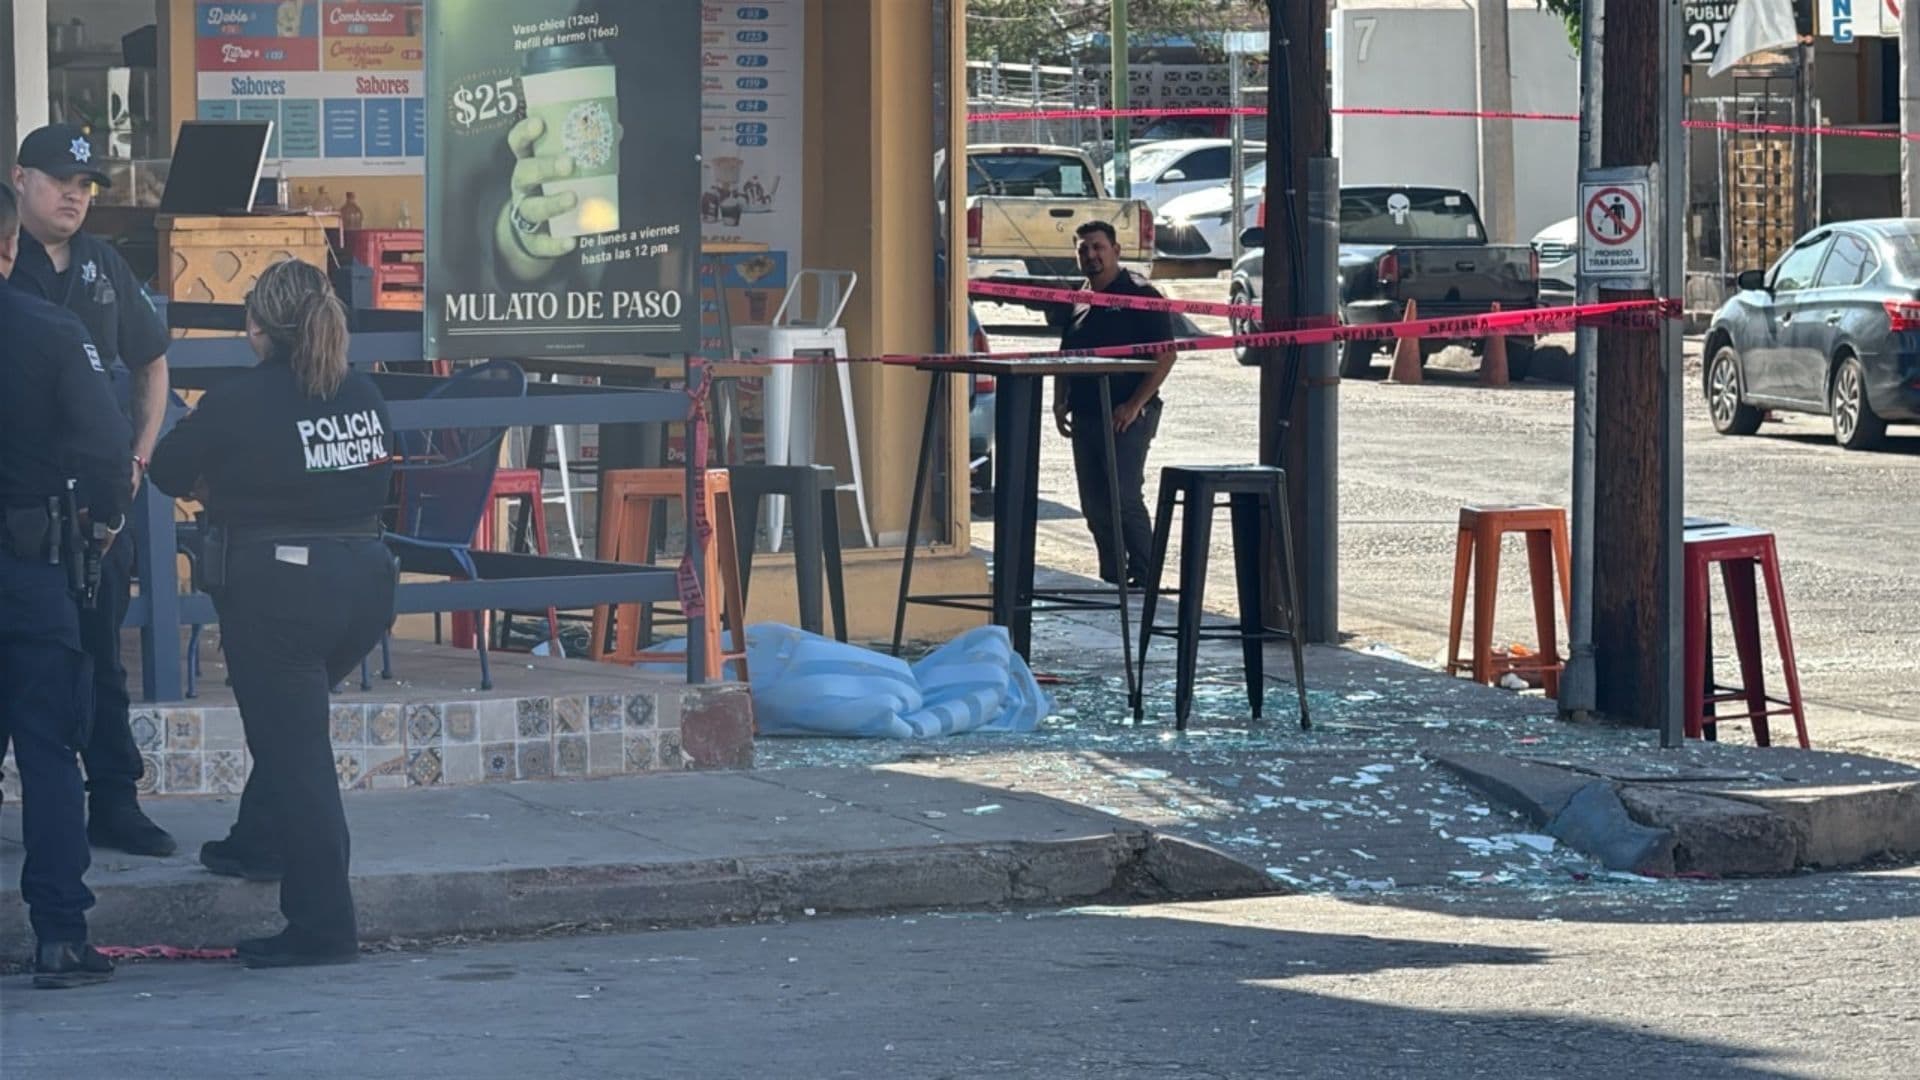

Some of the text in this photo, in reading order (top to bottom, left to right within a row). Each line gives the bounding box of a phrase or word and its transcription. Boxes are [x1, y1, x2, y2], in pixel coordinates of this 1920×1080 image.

[512, 23, 538, 36] Vaso
[567, 12, 600, 29] (12oz)
[514, 24, 619, 51] Refill de termo (16oz)
[1354, 18, 1378, 61] 7
[231, 75, 286, 96] Sabores
[355, 75, 409, 95] Sabores
[453, 77, 518, 129] $25
[580, 224, 680, 249] De lunes a viernes
[581, 243, 669, 265] hasta las 12 pm
[445, 290, 682, 322] MULATO DE PASO
[296, 409, 385, 446] POLICIA
[304, 435, 388, 469] MUNICIPAL
